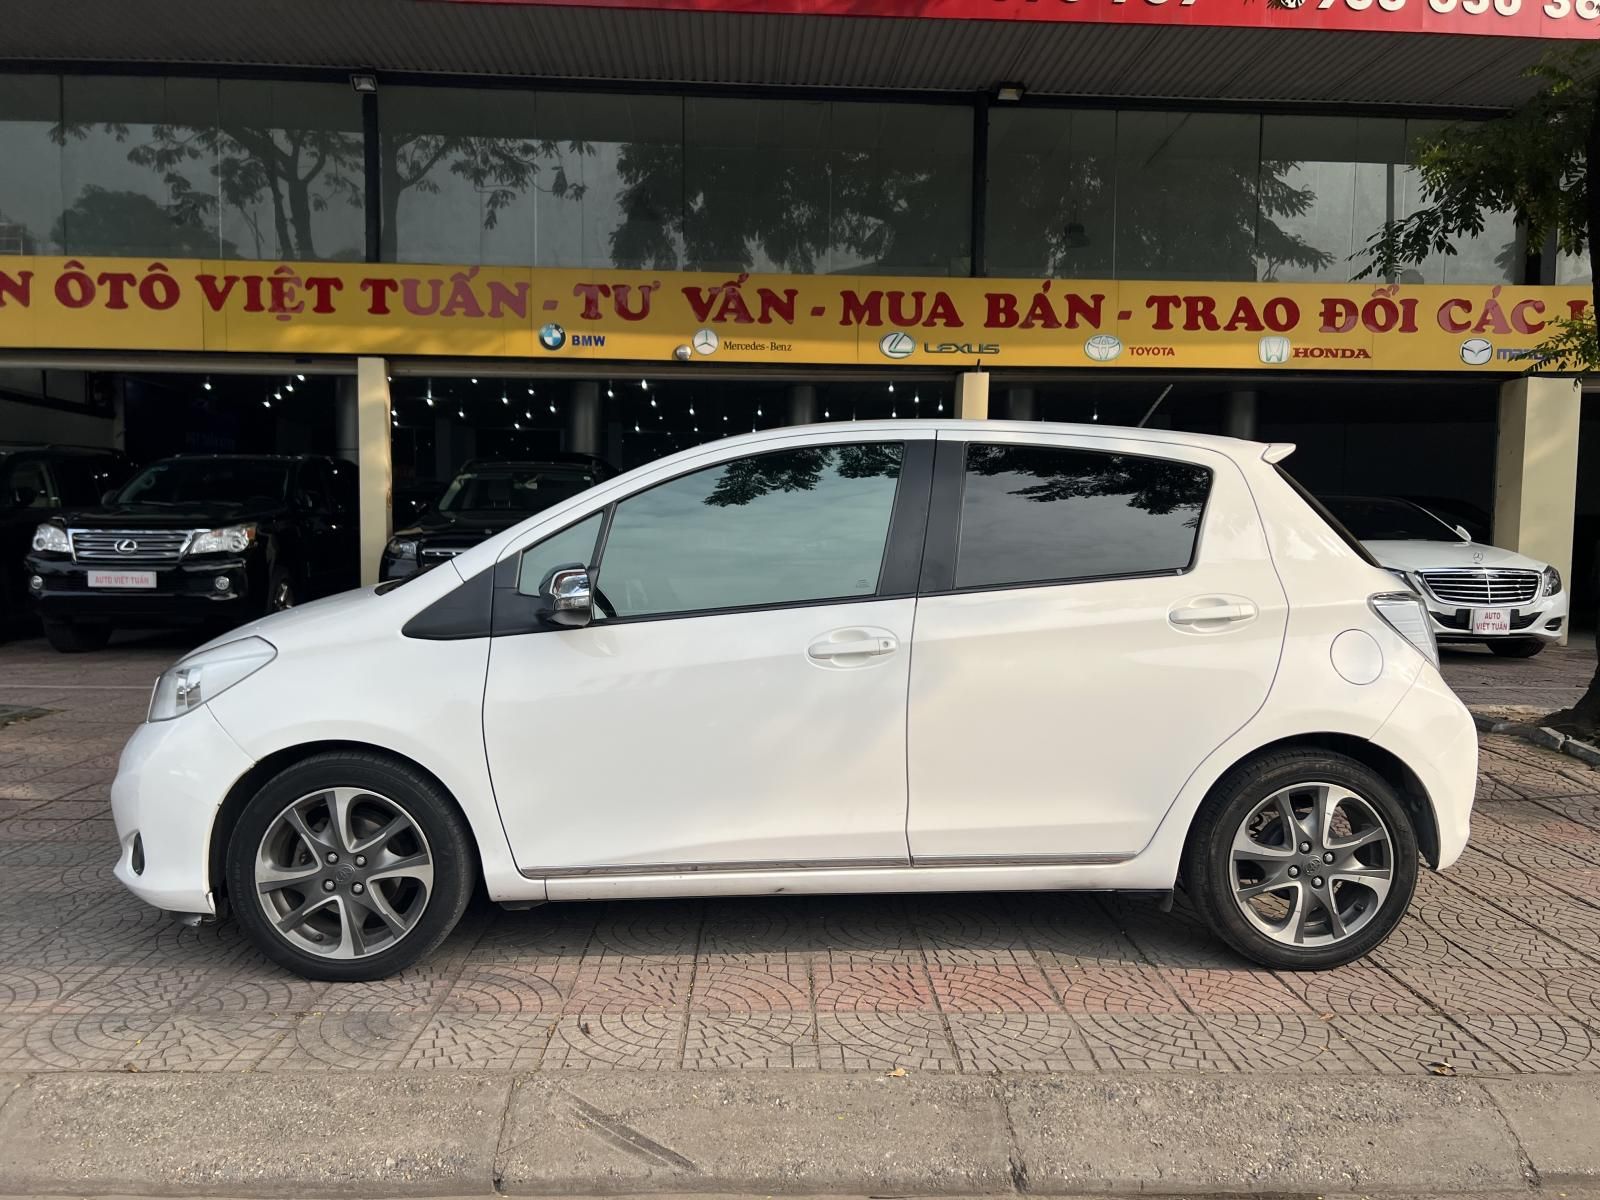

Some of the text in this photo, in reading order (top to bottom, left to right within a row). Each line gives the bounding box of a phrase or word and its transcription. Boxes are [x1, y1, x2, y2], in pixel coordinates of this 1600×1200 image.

[54, 260, 180, 311] ÔTÔ
[196, 265, 343, 322] VIỆT
[360, 265, 530, 318] TUẤN
[573, 280, 662, 322] TƯ
[681, 273, 799, 325] VẤN
[840, 290, 964, 328] MUA
[984, 278, 1106, 330] BÁN
[1145, 294, 1301, 333] TRAO
[1319, 283, 1418, 334] ĐỔI
[1436, 284, 1546, 335] CÁC
[571, 335, 606, 347] BMW
[924, 343, 1000, 355] LEXUS
[1128, 346, 1176, 357] TOYOTA
[1292, 347, 1372, 359] HONDA
[95, 575, 113, 585] AUTO
[1484, 611, 1502, 620] AUTO
